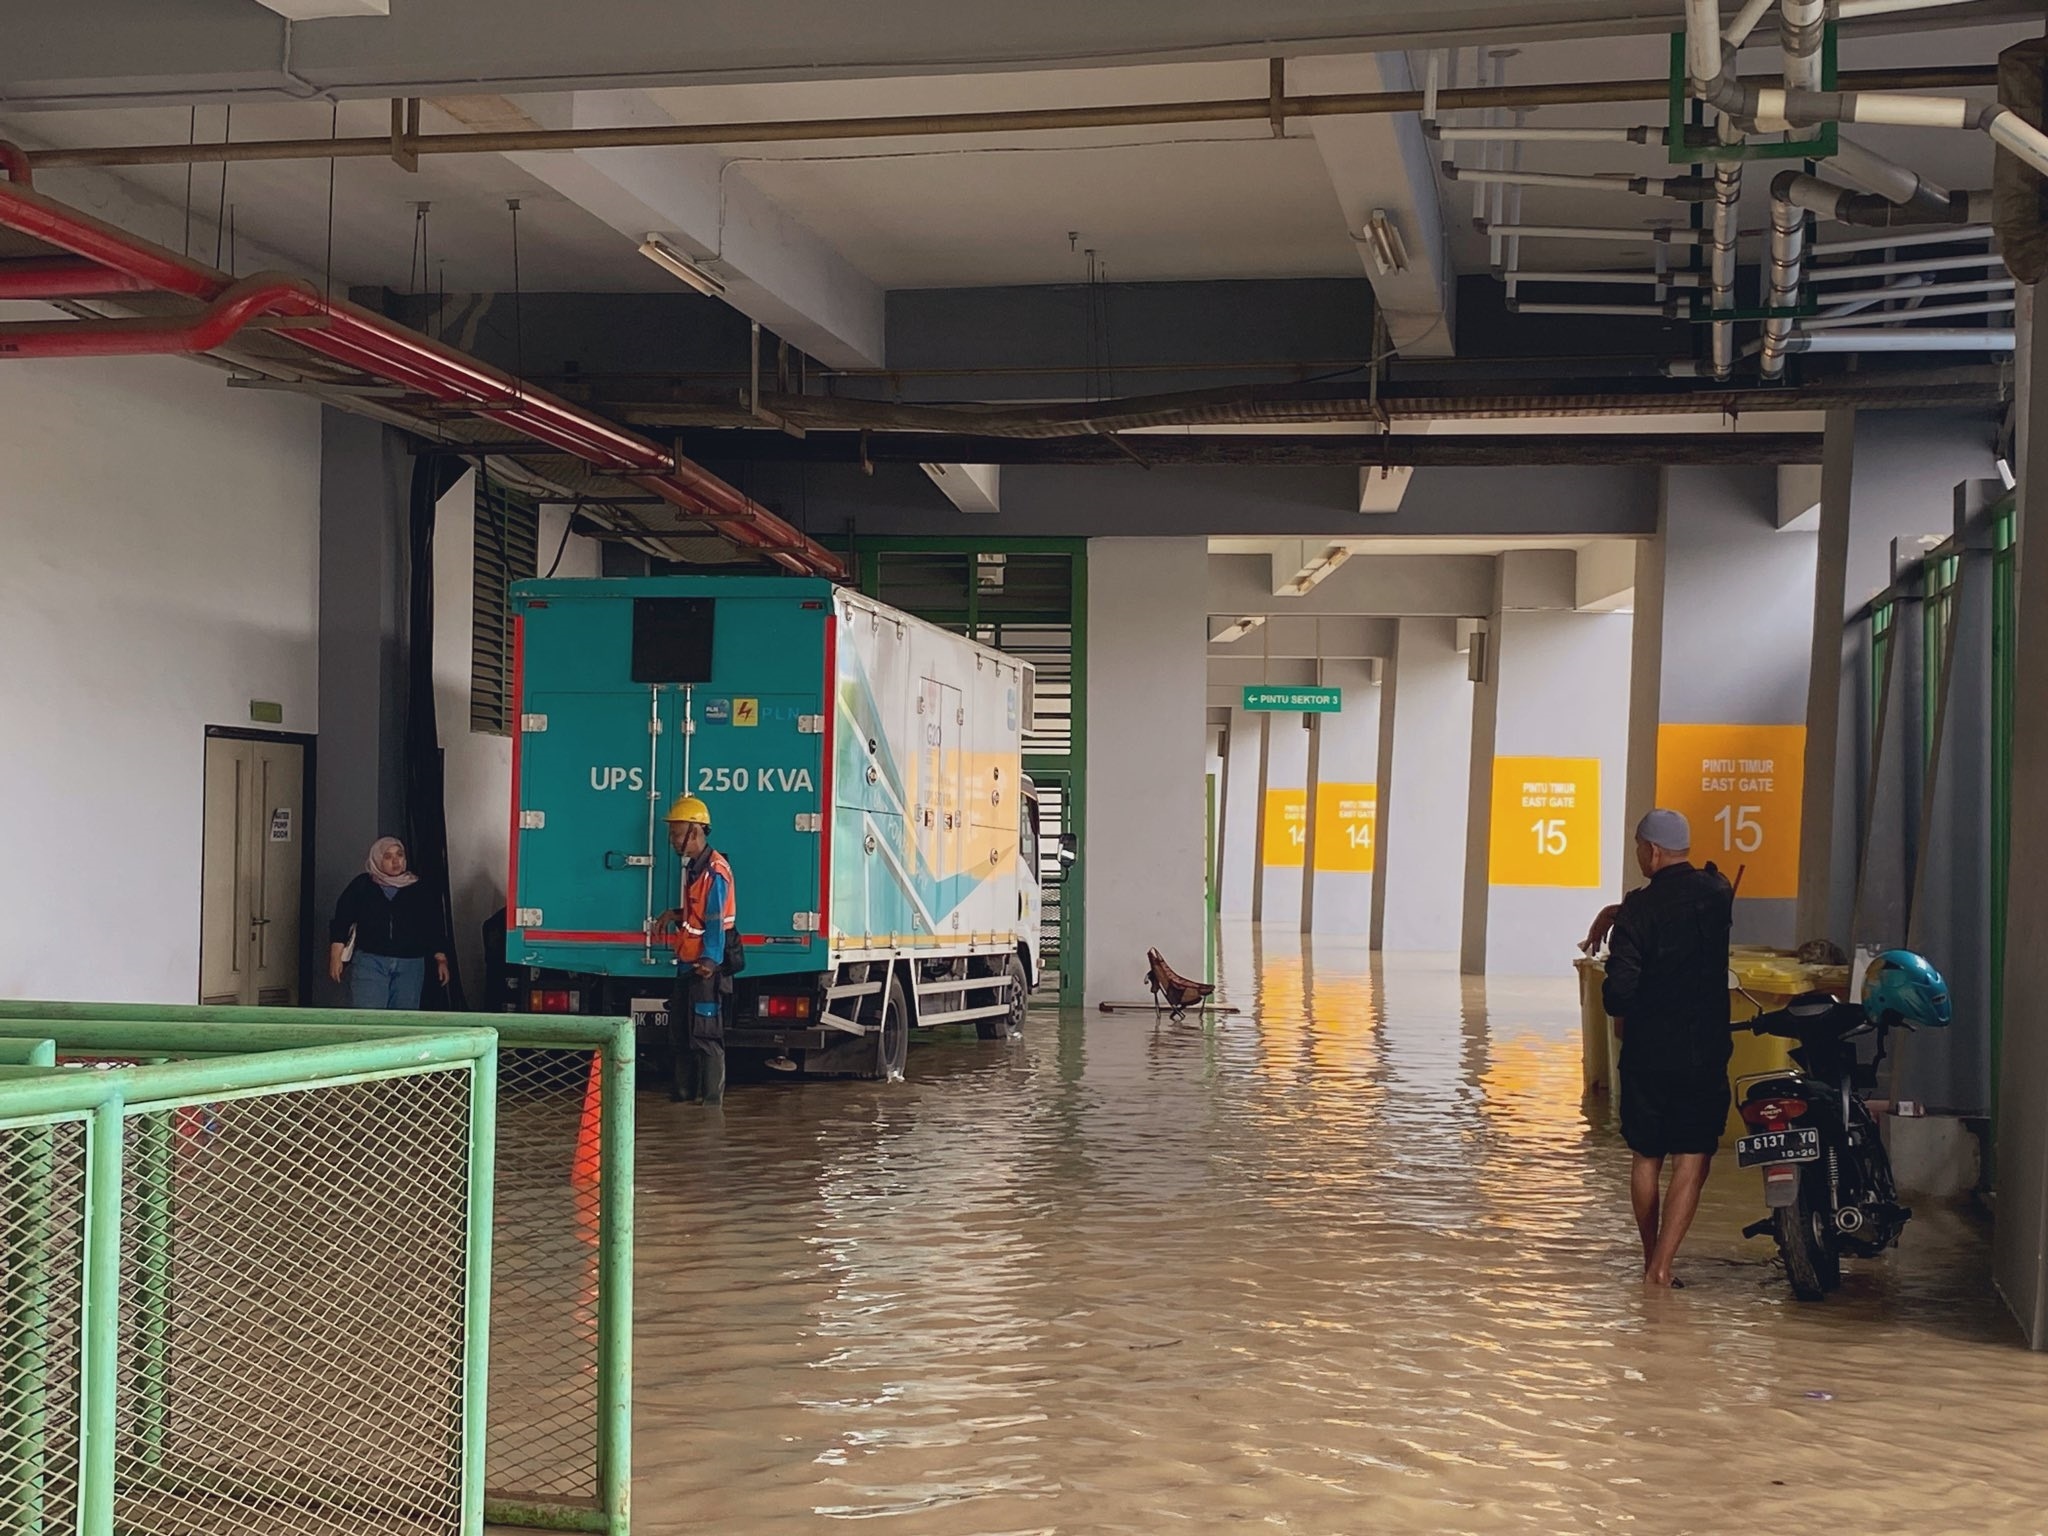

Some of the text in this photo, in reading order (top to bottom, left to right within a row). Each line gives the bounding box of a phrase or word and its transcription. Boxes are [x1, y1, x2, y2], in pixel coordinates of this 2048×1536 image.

[1260, 694, 1338, 704] PINTU SEKTOR 3
[1702, 759, 1774, 774] PINTU TIMUR
[590, 766, 814, 792] UPS 250 KVA
[1702, 777, 1774, 792] EAST GATE
[1523, 782, 1576, 794] PINTU TIMUR
[1522, 796, 1575, 808] EAST GATE
[1345, 824, 1371, 849] 14
[1530, 818, 1567, 855] 15
[1713, 804, 1763, 852] 15
[1738, 1141, 1746, 1153] B
[1753, 1134, 1785, 1150] 6137
